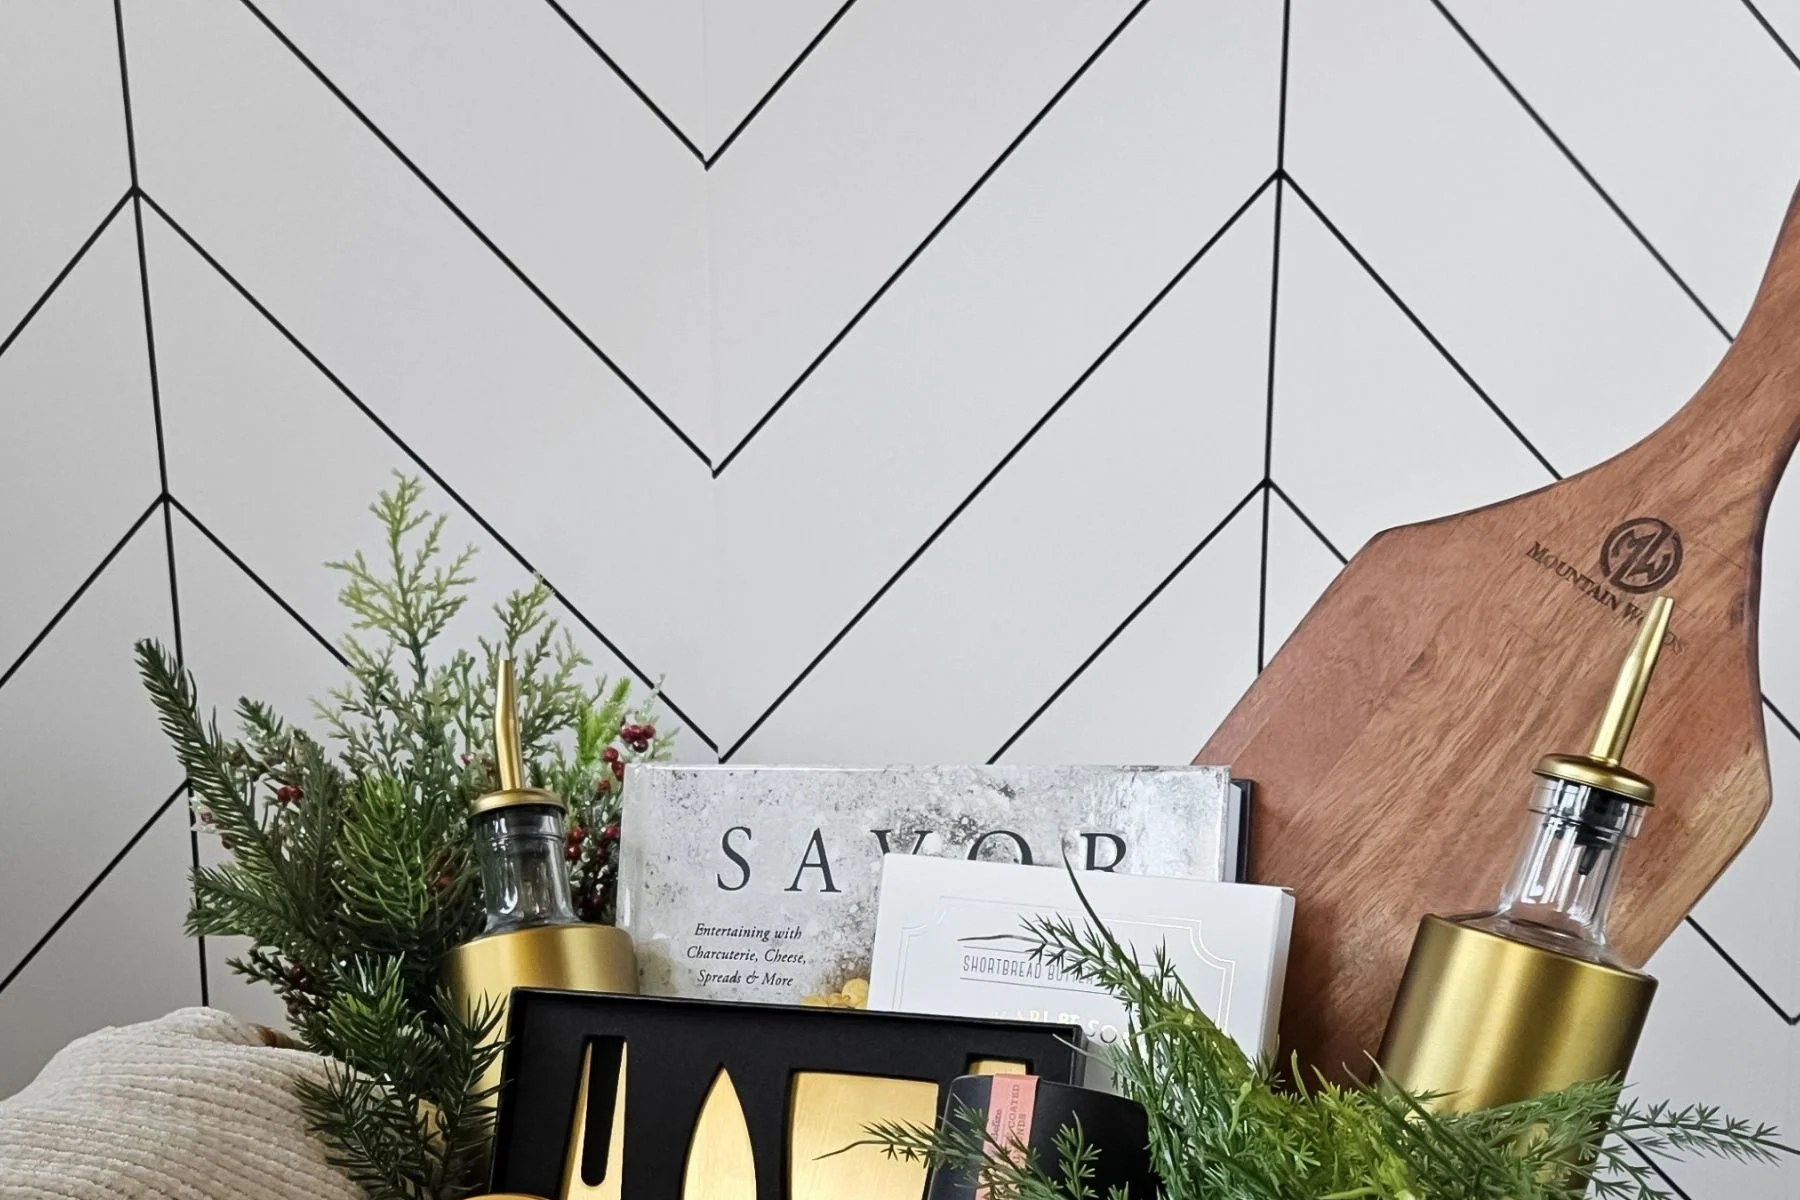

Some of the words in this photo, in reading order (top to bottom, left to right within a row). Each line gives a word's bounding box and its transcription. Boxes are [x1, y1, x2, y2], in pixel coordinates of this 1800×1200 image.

[1526, 541, 1623, 610] MOUNTAIN
[694, 923, 771, 942] Entertaining
[774, 926, 802, 940] with
[687, 946, 759, 962] Charcuterie,
[764, 949, 806, 964] Cheese,
[697, 969, 742, 986] Spreads
[746, 971, 759, 984] &
[761, 972, 794, 986] More
[1008, 1084, 1020, 1128] COATED
